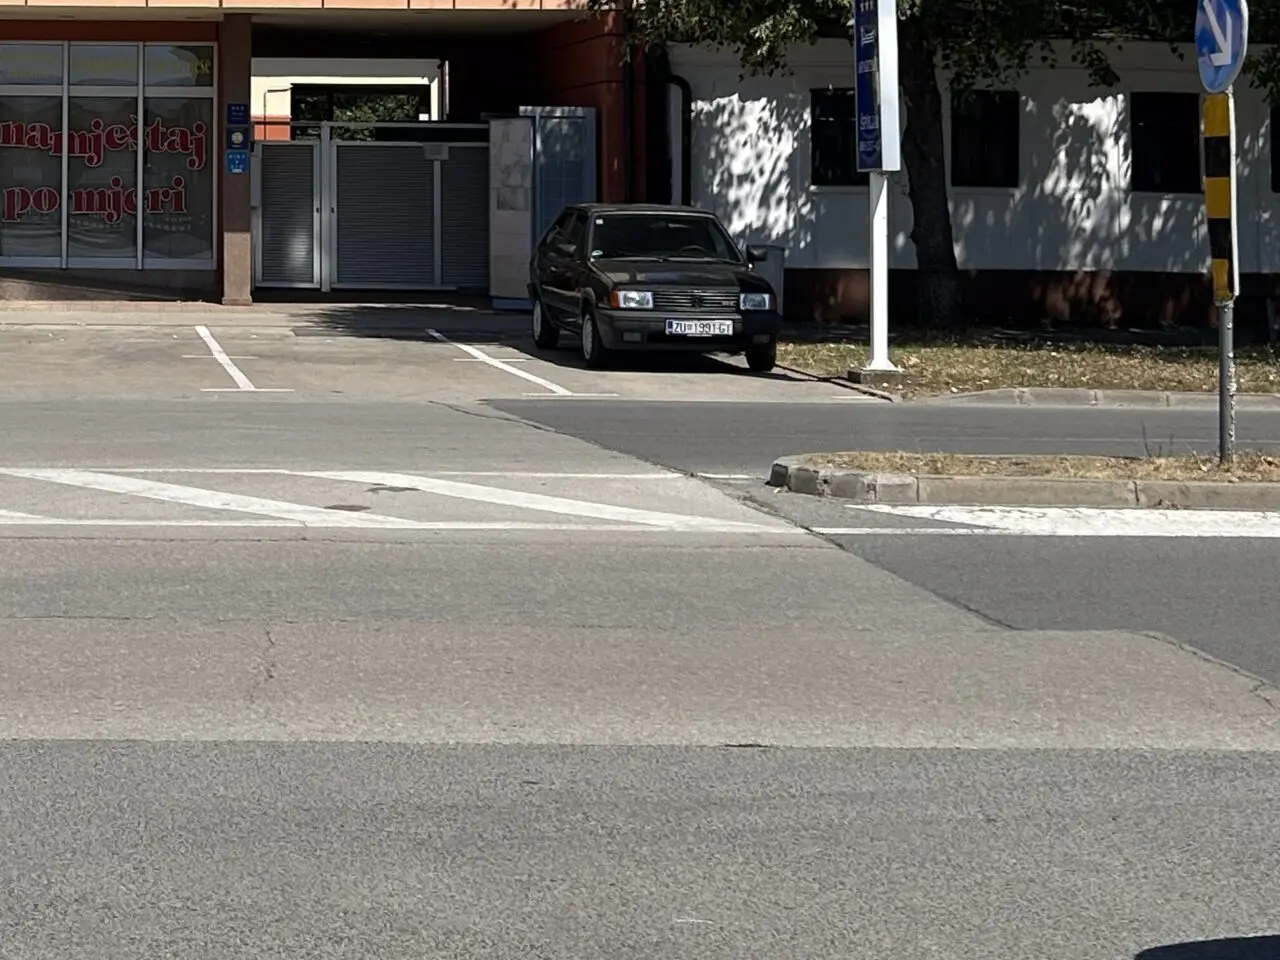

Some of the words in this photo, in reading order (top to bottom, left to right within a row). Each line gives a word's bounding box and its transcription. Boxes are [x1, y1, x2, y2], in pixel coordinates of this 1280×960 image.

[2, 187, 60, 223] po
[70, 175, 187, 224] mjeri
[674, 322, 686, 334] ZU
